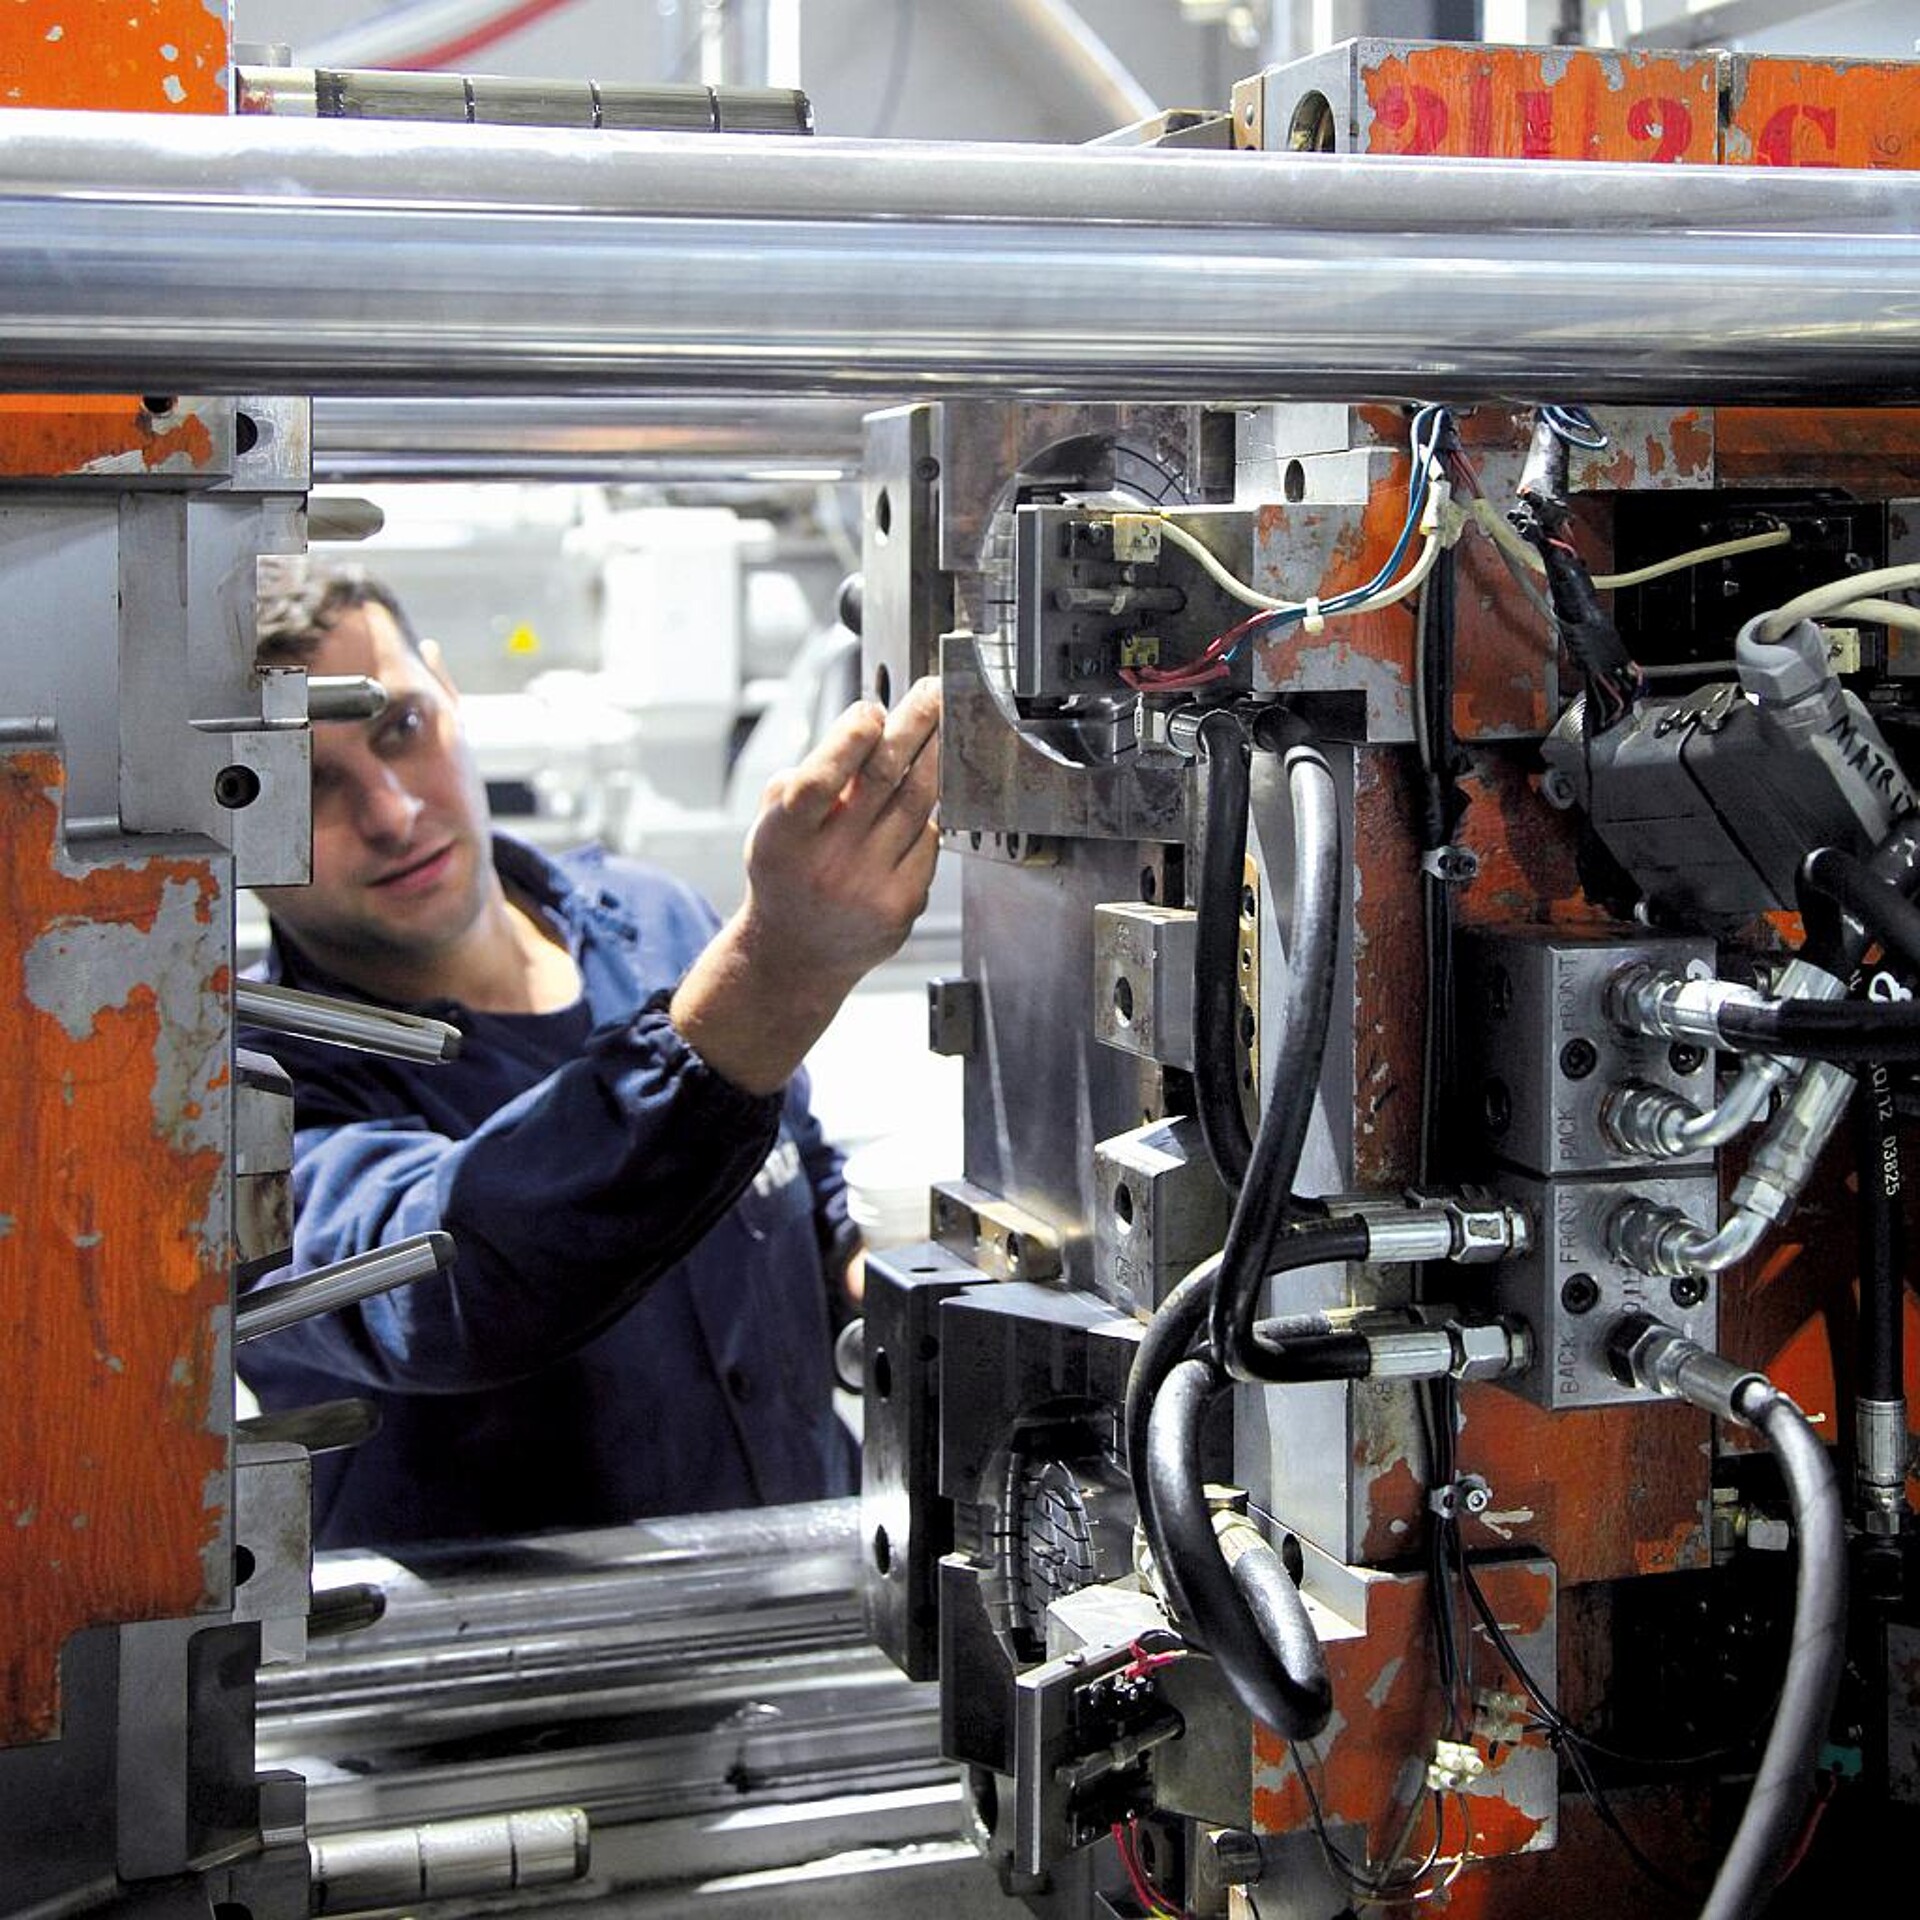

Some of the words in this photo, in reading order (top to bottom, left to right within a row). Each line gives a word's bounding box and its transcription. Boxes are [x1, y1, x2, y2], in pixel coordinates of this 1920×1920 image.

[1558, 956, 1579, 1032] FRONT
[1881, 1135, 1901, 1196] 03825
[1557, 1337, 1580, 1394] BACK
